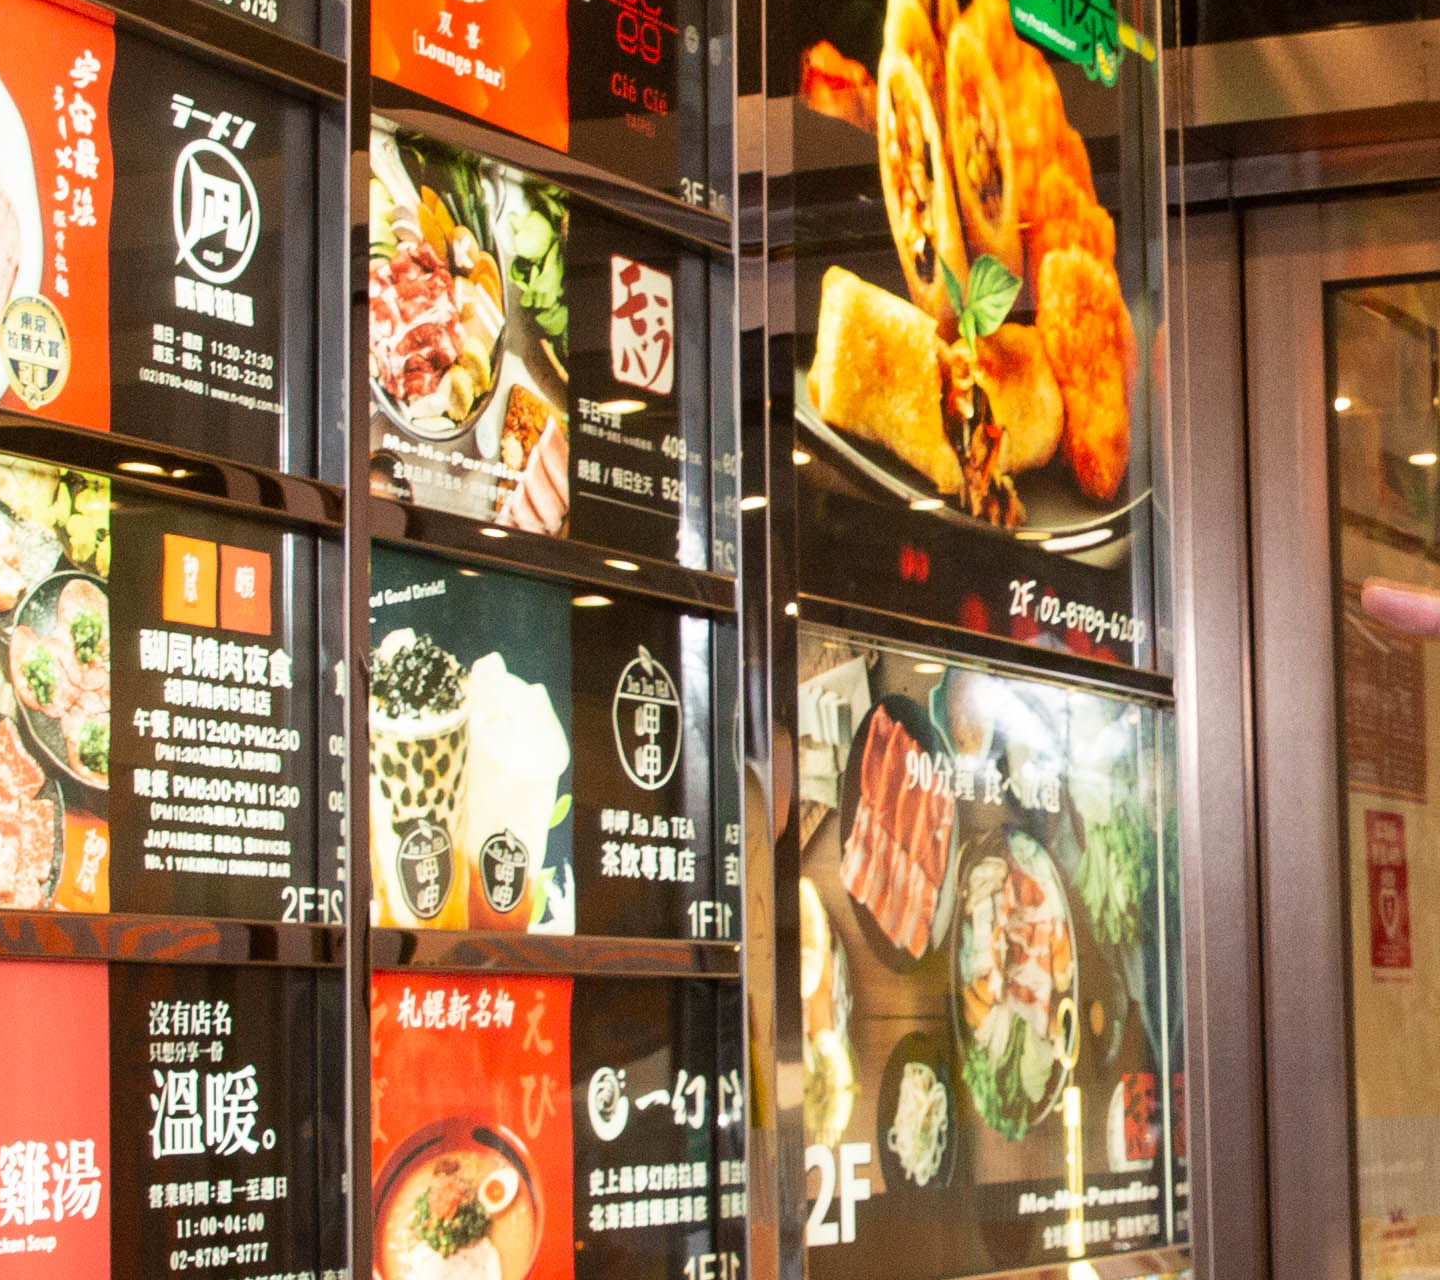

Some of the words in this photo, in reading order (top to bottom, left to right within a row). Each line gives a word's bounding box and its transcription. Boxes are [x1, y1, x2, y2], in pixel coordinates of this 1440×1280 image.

[171, 93, 256, 150] ラーメン
[680, 178, 705, 205] 3F
[1009, 580, 1036, 618] 2F
[281, 886, 316, 923] 2F
[688, 902, 714, 938] 1F
[149, 1000, 232, 1037] 沒有店名
[398, 987, 516, 1032] 札幌新名物
[149, 1040, 224, 1063] 只想分享一份
[804, 1142, 871, 1247] 2F
[26, 1233, 57, 1253] Soup
[169, 1242, 268, 1271] 02-8789-3777
